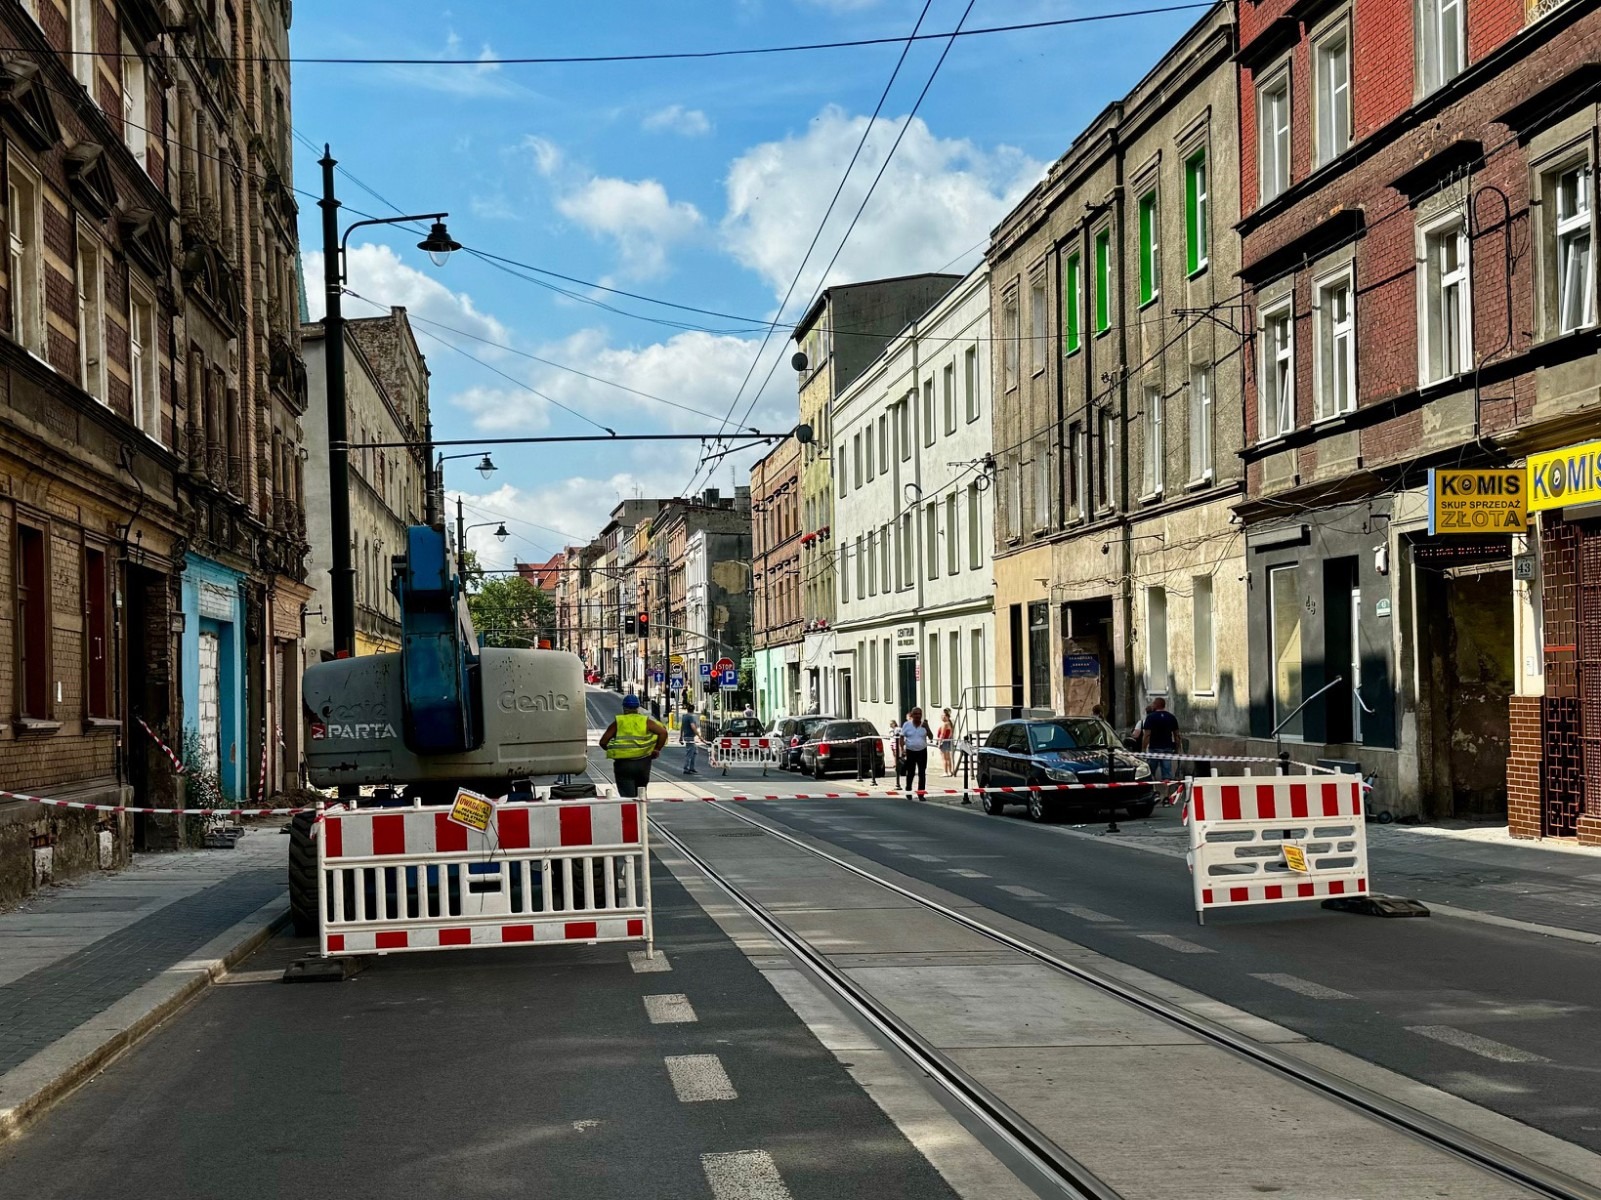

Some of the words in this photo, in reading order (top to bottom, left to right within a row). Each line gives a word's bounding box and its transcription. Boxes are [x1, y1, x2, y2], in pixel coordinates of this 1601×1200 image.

[1441, 474, 1520, 496] KOMIS
[1441, 501, 1467, 509] SKUP
[1469, 499, 1521, 509] SPRZEDAŻ
[1441, 511, 1521, 527] ZŁOTA
[1517, 563, 1531, 573] 43
[725, 671, 735, 683] P
[497, 689, 570, 713] Genie
